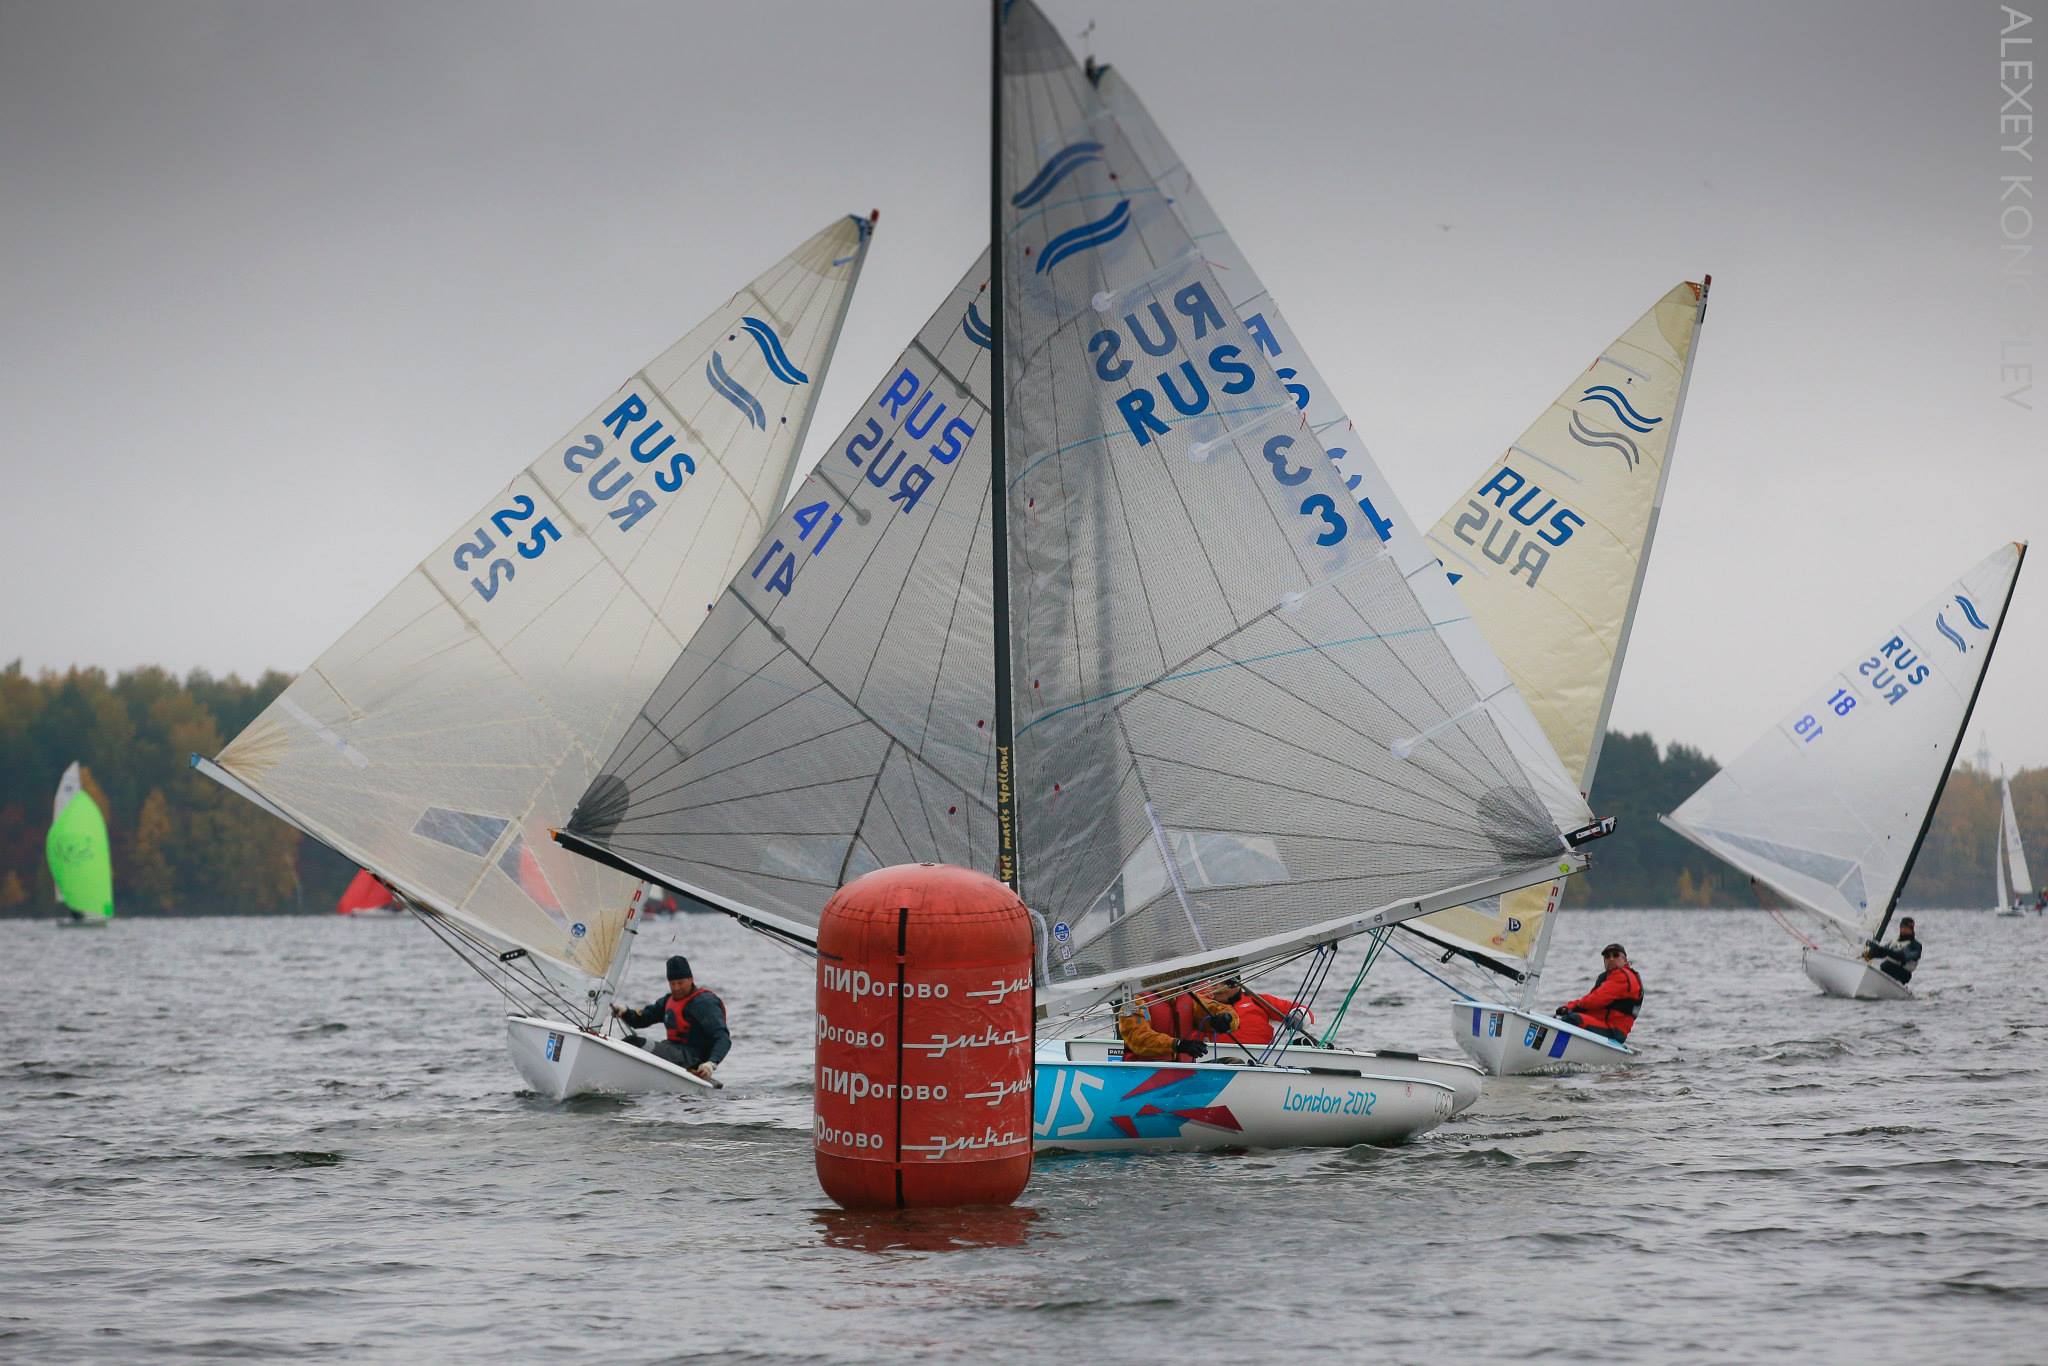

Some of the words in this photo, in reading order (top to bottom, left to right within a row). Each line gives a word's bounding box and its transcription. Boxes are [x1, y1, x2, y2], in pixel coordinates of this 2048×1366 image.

[879, 367, 976, 466] RUS
[1115, 344, 1256, 447] RUS
[602, 392, 697, 494] RUS
[490, 495, 562, 561] 25
[793, 500, 844, 558] 41
[1478, 466, 1585, 547] RUS
[1880, 635, 1931, 686] RUS
[1826, 688, 1857, 717] 18
[997, 745, 1012, 804] Holland
[816, 1012, 886, 1048] рогово
[1033, 1069, 1105, 1136] US
[1283, 1085, 1341, 1114] London
[1343, 1090, 1377, 1117] 2012
[815, 1113, 884, 1149] рогово
